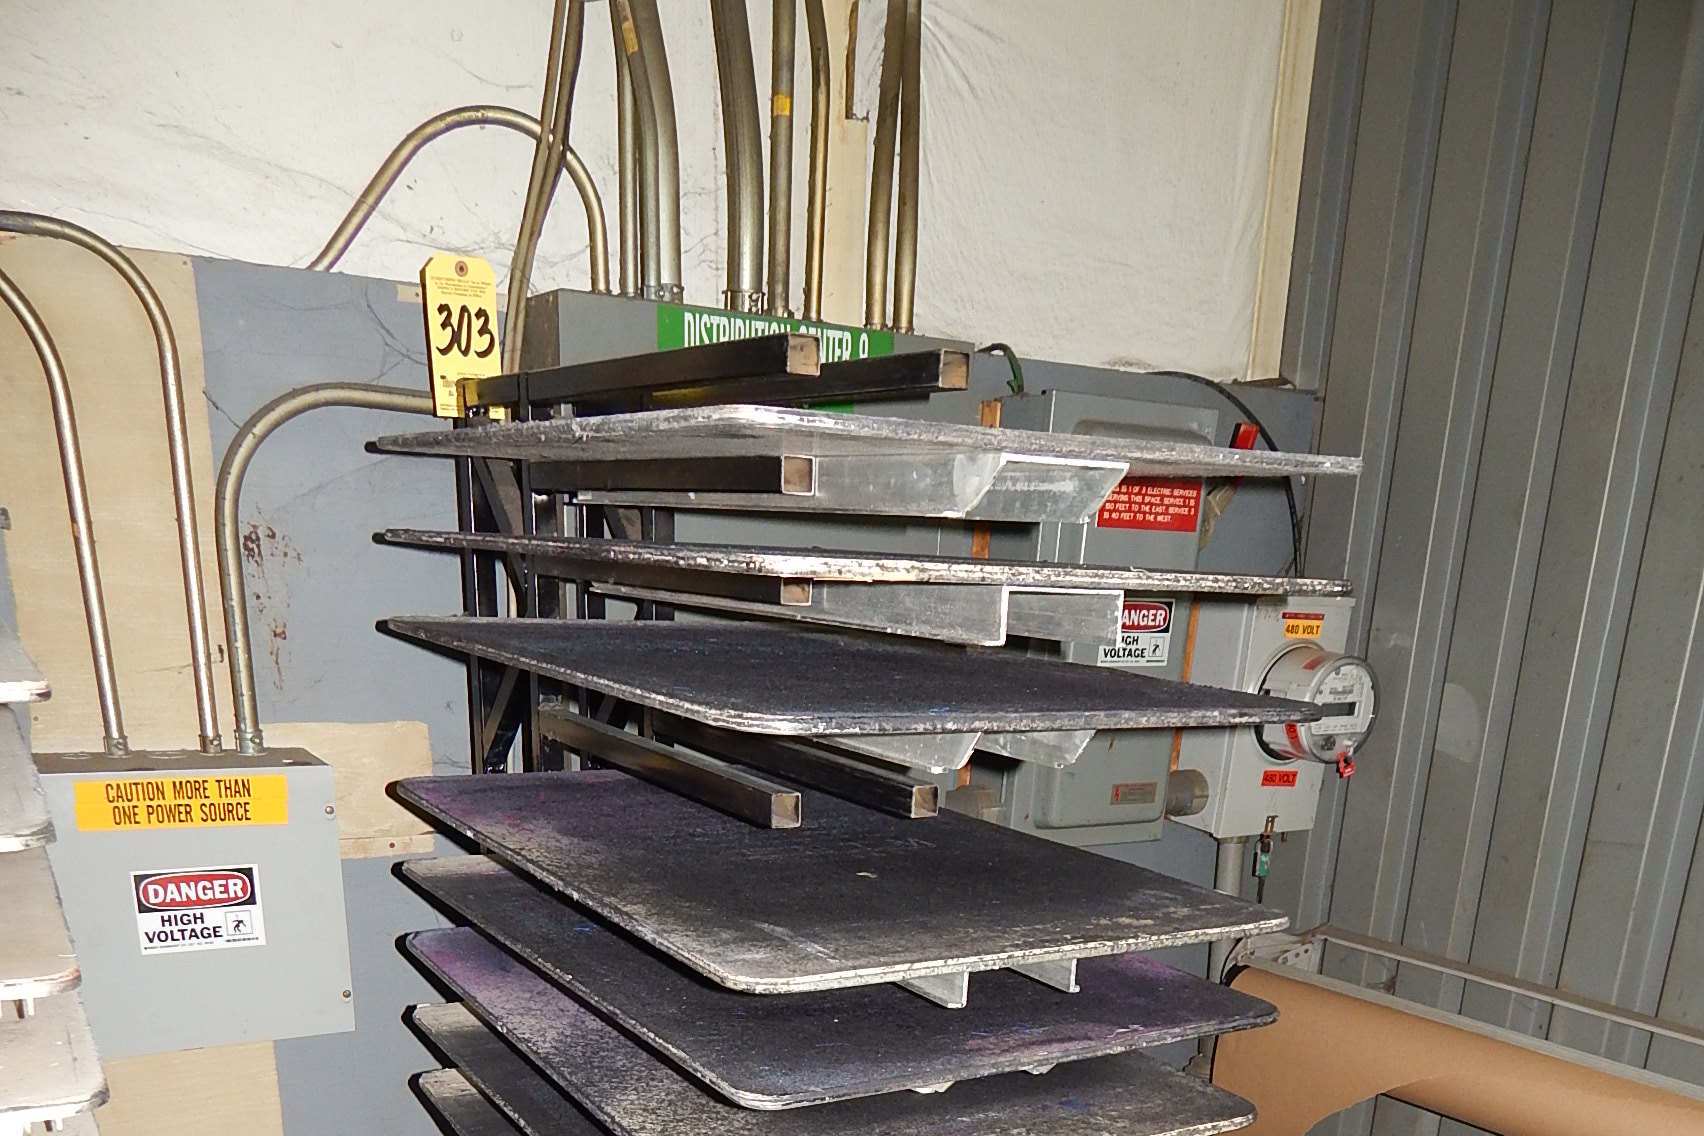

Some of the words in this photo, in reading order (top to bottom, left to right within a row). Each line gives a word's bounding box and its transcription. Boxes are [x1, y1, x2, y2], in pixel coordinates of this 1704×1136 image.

[437, 303, 496, 358] 303
[684, 312, 790, 347] DISTRIBUT
[799, 326, 852, 363] NTER
[1147, 487, 1172, 496] ELECTRIC
[1173, 488, 1198, 498] SERVICES
[1163, 497, 1184, 506] SERVICE
[1132, 504, 1139, 512] TO
[1168, 506, 1189, 514] SERVICE
[1120, 512, 1134, 520] FEET
[1122, 610, 1166, 626] ANGER
[1285, 624, 1300, 634] 480
[1302, 624, 1320, 634] VOLT
[1122, 636, 1140, 646] IGH
[1104, 648, 1146, 658] VOLTAGE
[1278, 774, 1297, 783] VOLT
[105, 780, 166, 804] CAUTION
[172, 779, 210, 800] MORE
[216, 778, 252, 798] THAN
[112, 804, 140, 826] ONE
[146, 803, 194, 824] POWER
[200, 802, 252, 822] SOURCE
[147, 878, 245, 904] DANGER
[160, 912, 205, 928] HIGH
[144, 926, 224, 944] VOLTAGE
